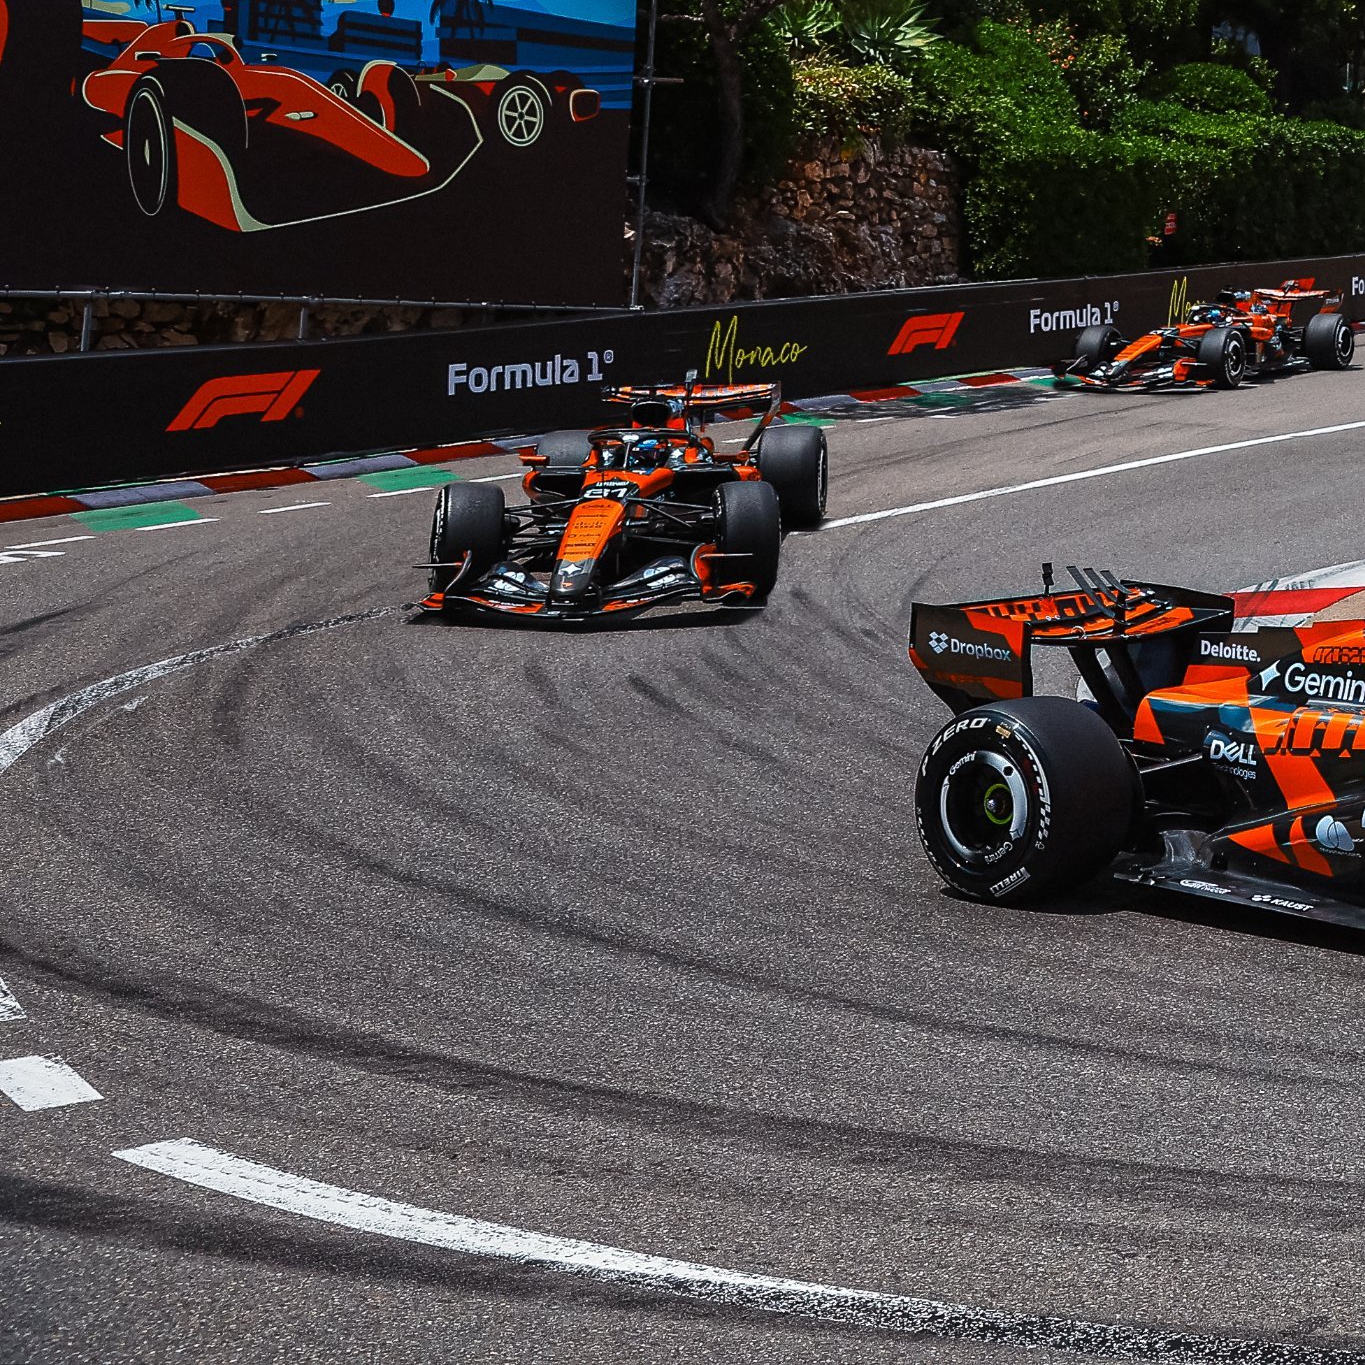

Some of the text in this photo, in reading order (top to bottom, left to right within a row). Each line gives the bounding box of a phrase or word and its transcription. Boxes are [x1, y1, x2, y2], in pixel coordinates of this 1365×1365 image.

[1029, 303, 1101, 334] Formula
[705, 315, 808, 384] Monaco
[448, 354, 579, 396] Formula
[950, 637, 1012, 663] Dropbox
[1200, 639, 1261, 663] Deloitte.
[932, 716, 988, 756] ZERO
[948, 750, 978, 776] Gemini
[1209, 739, 1258, 767] DELL
[1270, 897, 1315, 913] KAUST
